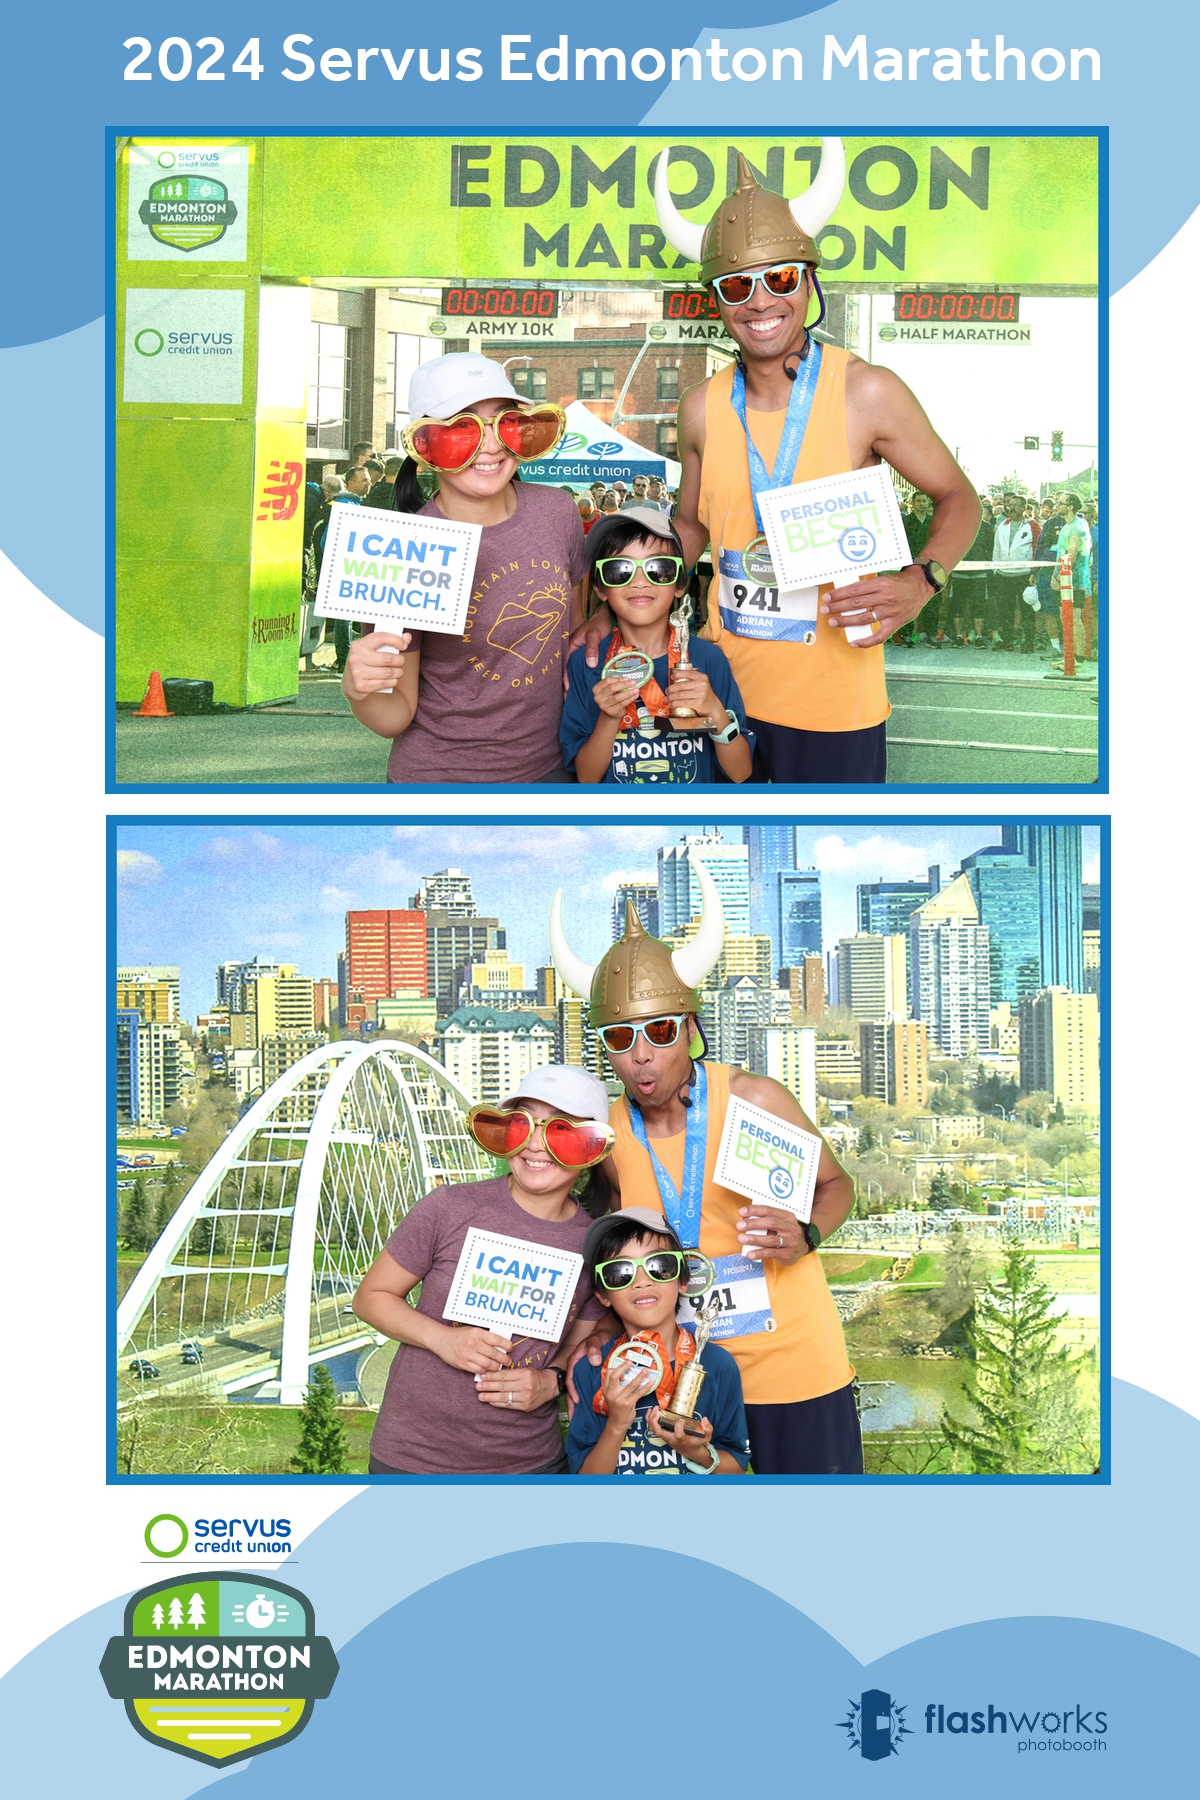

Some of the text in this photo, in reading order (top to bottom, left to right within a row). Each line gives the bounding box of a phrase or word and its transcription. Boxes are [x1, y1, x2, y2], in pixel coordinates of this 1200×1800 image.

[178, 152, 219, 161] servus
[149, 203, 227, 214] EDMONTON
[160, 214, 215, 222] MARATHON
[168, 331, 233, 345] servus
[466, 321, 554, 336] ARMY 10K
[900, 328, 939, 340] HALF
[943, 329, 1031, 341] MARATHON
[168, 345, 233, 355] credit union
[797, 369, 811, 406] MARATHON
[785, 426, 797, 448] union
[548, 463, 590, 477] credit
[593, 466, 631, 477] union
[780, 491, 875, 523] PERSONAL
[783, 504, 883, 554] BEST!
[347, 531, 457, 566] I CAN'T
[343, 557, 452, 590] WAIT FOR
[338, 579, 446, 612] BRUNCH.
[462, 558, 569, 643] MOUNTAIN LOVE
[733, 584, 781, 613] 941
[257, 613, 291, 643] Running
[736, 627, 773, 637] MARATHON
[737, 615, 773, 628] ADRIAN
[468, 656, 501, 682] KEEP
[511, 675, 534, 687] ON
[613, 737, 704, 759] DMONTON
[740, 1119, 805, 1160] PERSONAL
[735, 1132, 804, 1186] BEST!
[688, 1185, 696, 1209] servus
[476, 1252, 563, 1287] I CAN'T
[471, 1273, 556, 1306] WAIT FOR
[689, 1288, 736, 1312] 941
[464, 1291, 548, 1323] BRUNCH.
[709, 1328, 736, 1338] RATHON
[711, 1317, 734, 1328] RIAN
